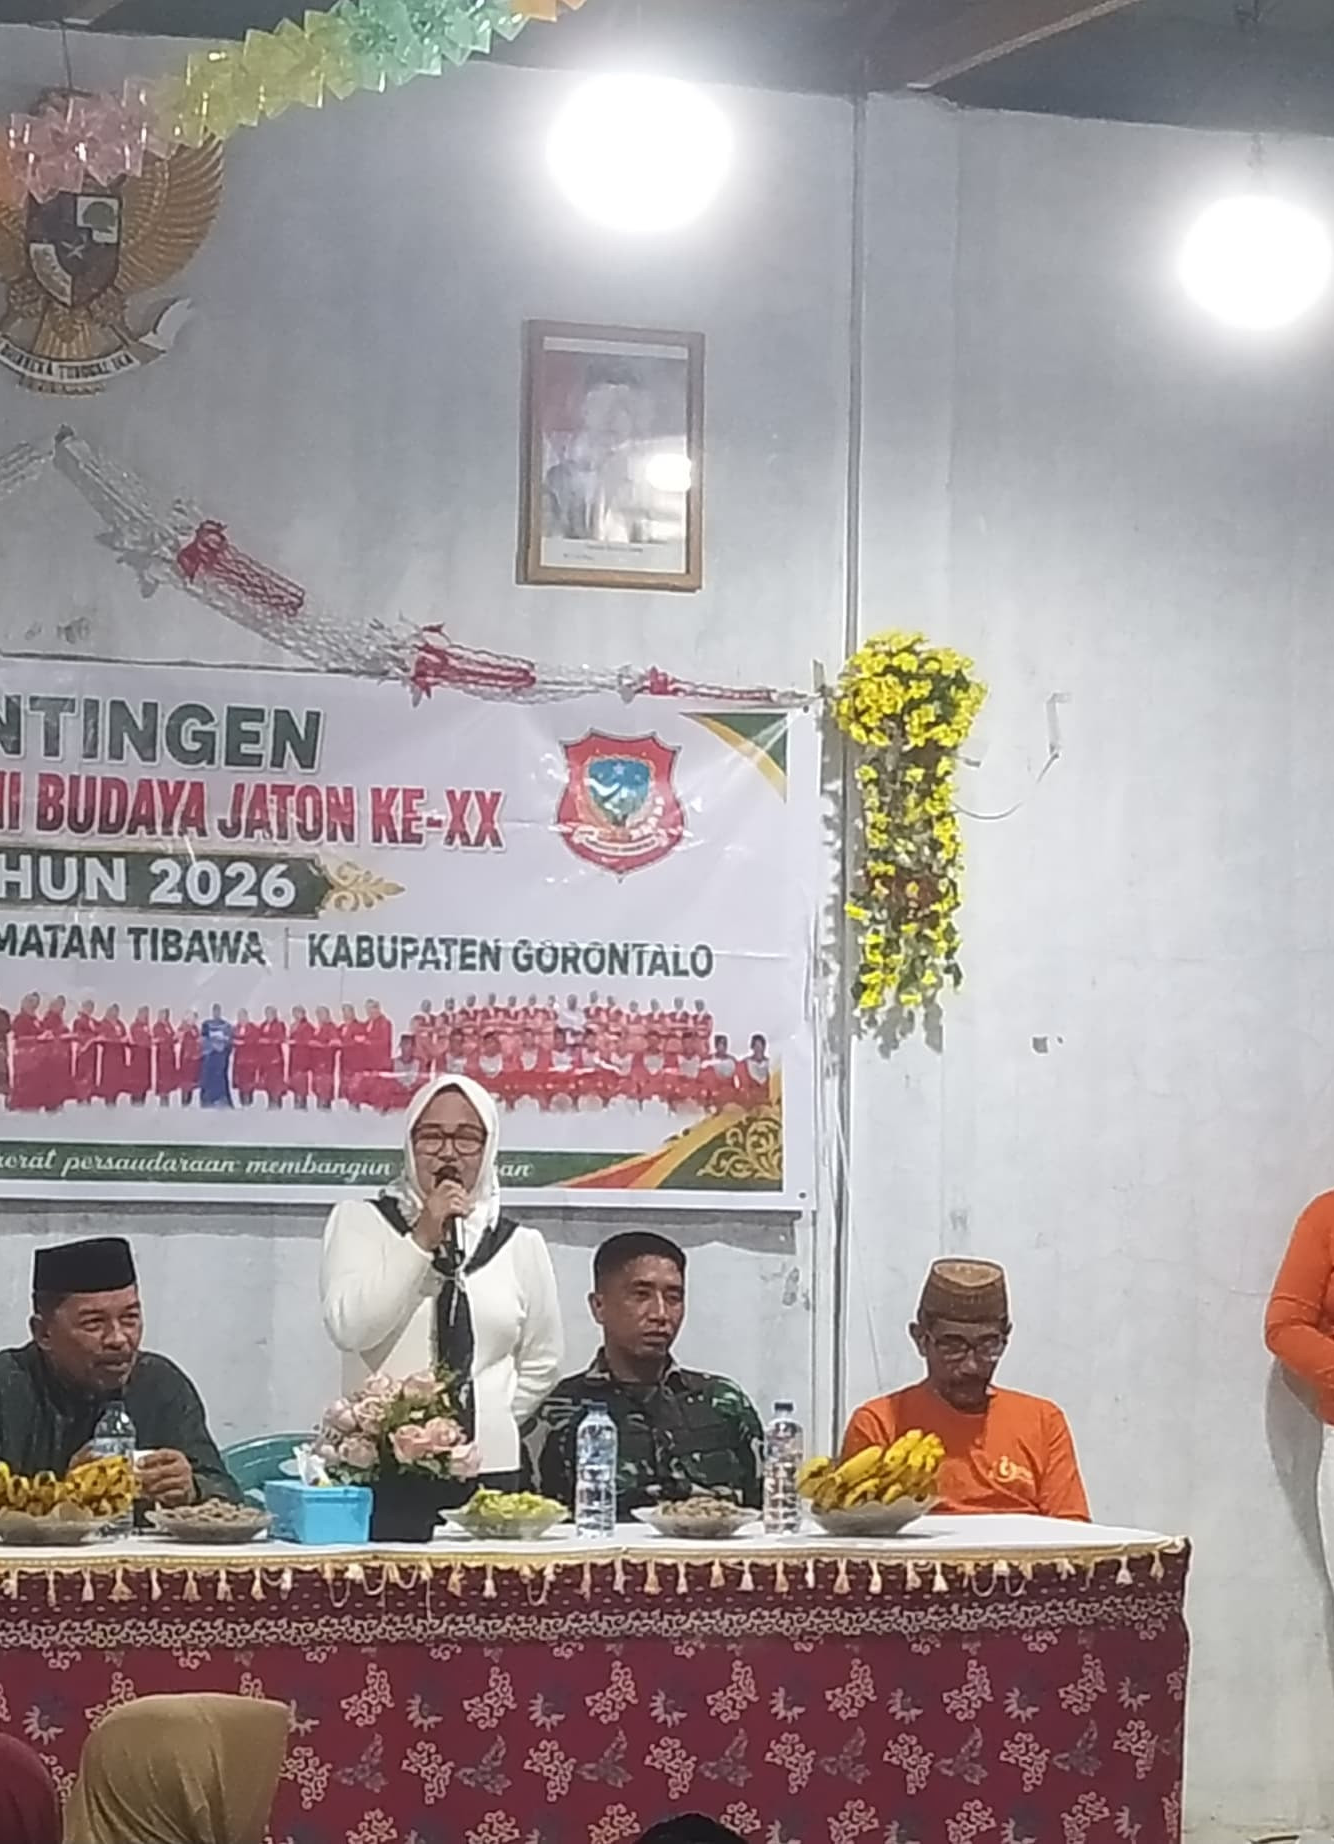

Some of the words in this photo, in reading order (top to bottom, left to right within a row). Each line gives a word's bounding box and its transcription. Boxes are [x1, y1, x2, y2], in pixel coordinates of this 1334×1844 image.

[35, 772, 208, 839] BUDAYA
[217, 781, 356, 844] JATON
[370, 786, 505, 849] KE-XX
[148, 857, 297, 908] 2026
[126, 926, 268, 966] TIBAWA
[307, 933, 502, 973] KABUPATEN
[512, 938, 715, 979] GORONTALO
[60, 1151, 238, 1178] persaudaraan
[245, 1152, 391, 1184] membangun
